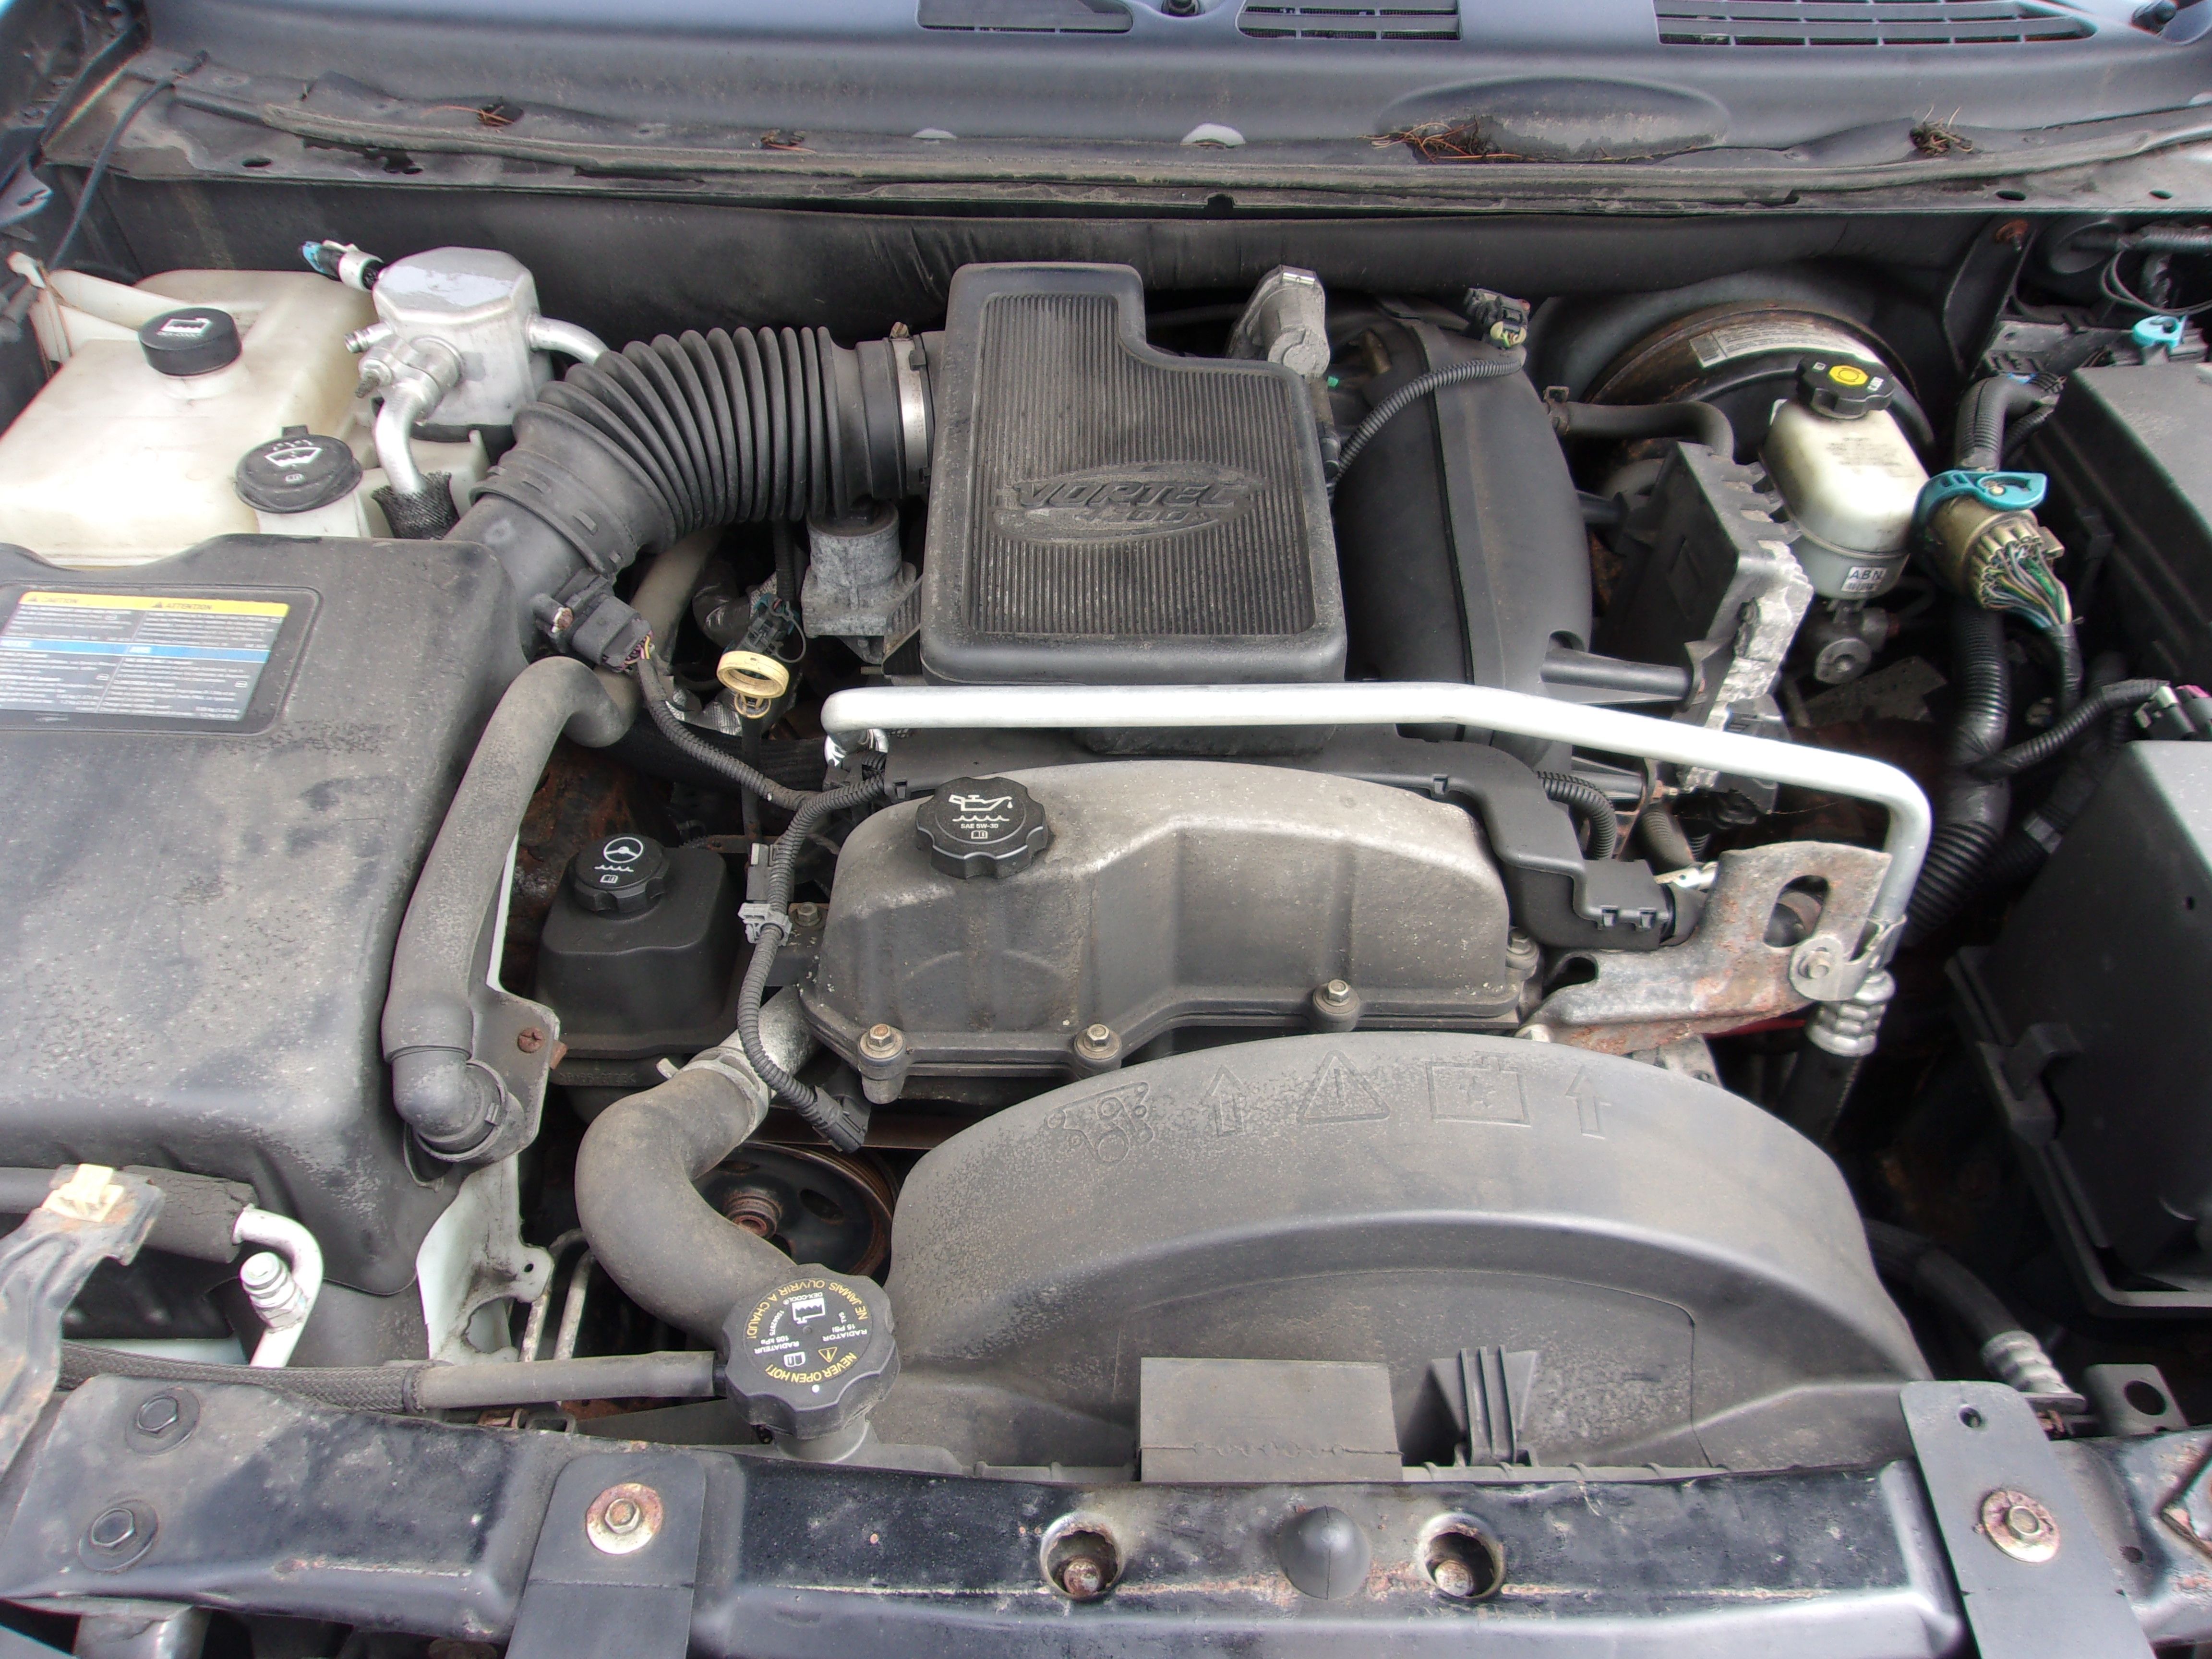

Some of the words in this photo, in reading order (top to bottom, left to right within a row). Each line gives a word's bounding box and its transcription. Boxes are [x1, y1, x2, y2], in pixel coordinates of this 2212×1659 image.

[1012, 480, 1253, 509] VORTEC
[1849, 570, 1883, 580] ABN
[777, 1279, 825, 1296] OUVRIR
[829, 1282, 862, 1305] JAMAIS
[746, 1301, 770, 1339] CHAUD!
[854, 1305, 868, 1321] NE
[776, 1335, 789, 1343] 105
[822, 1329, 867, 1342] RADIATOR
[754, 1341, 800, 1354] RADIATEUR
[765, 1364, 791, 1381] HOT!
[821, 1352, 857, 1379] NEVER
[791, 1371, 822, 1383] OPEN
